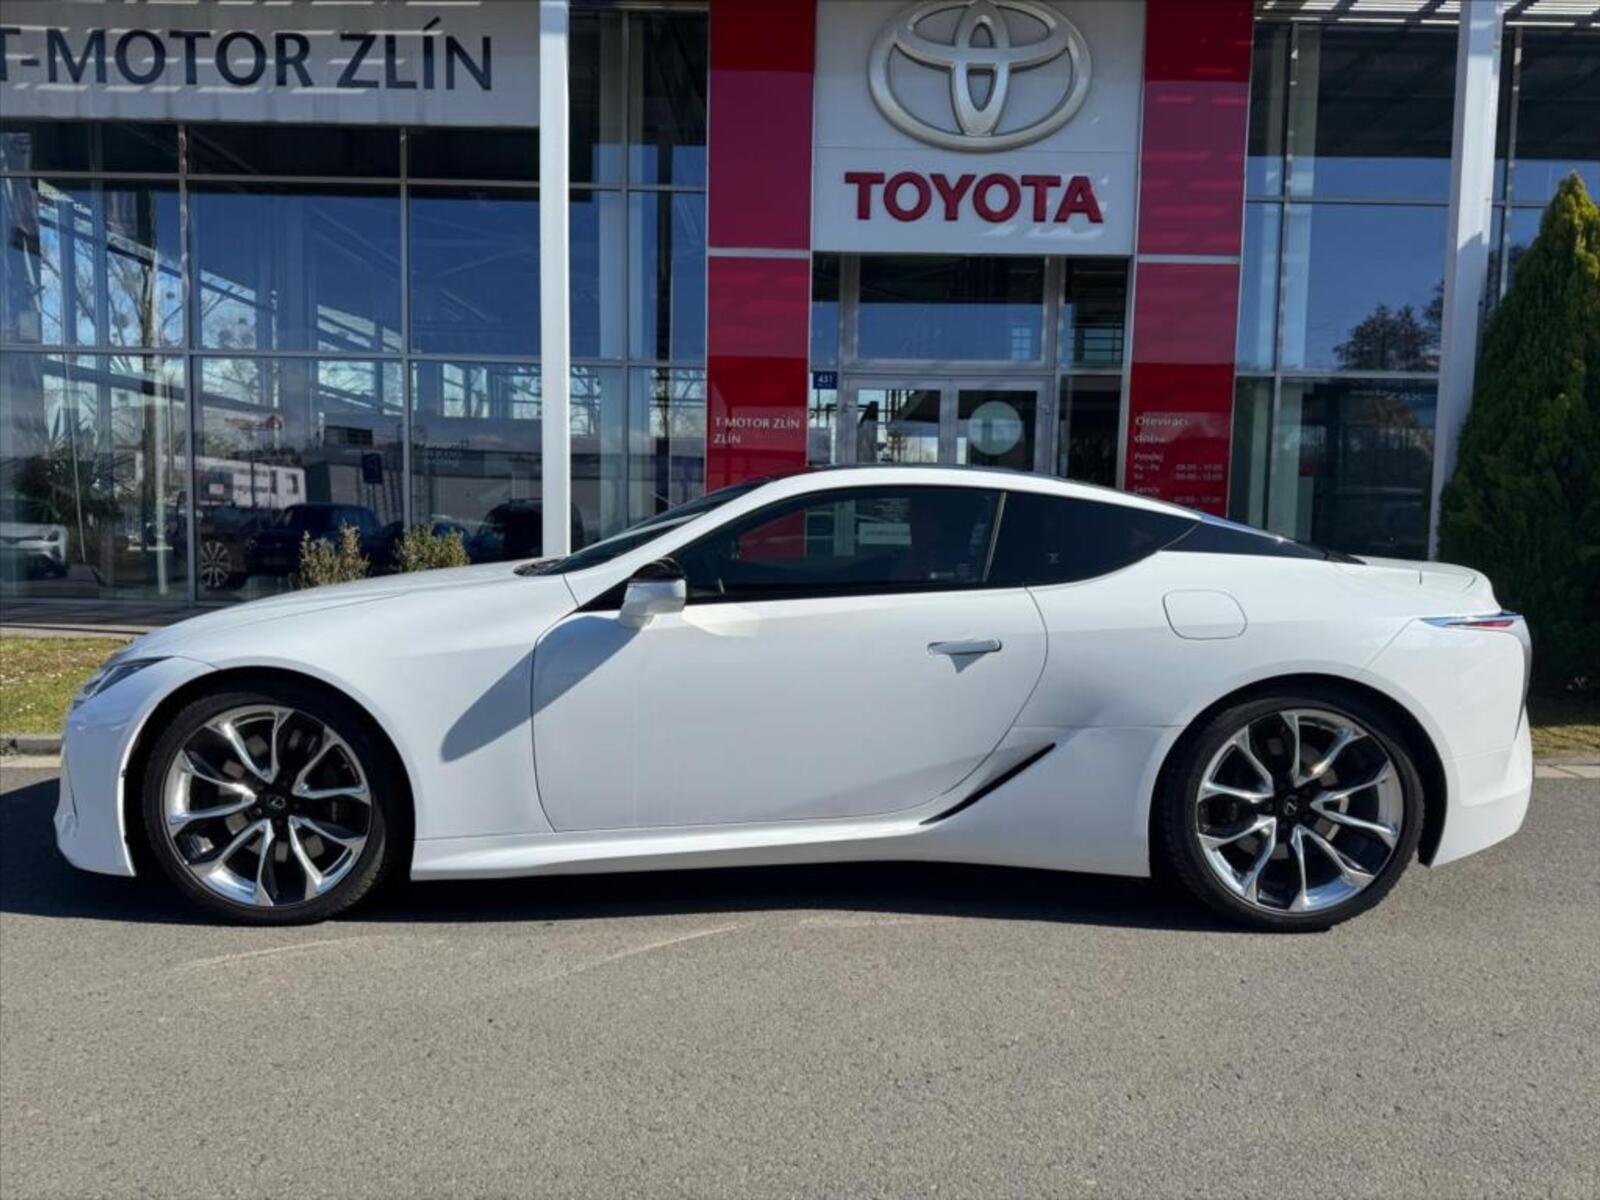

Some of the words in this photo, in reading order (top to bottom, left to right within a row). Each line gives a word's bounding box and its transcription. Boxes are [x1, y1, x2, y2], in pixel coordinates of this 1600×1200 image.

[0, 27, 313, 88] T-MOTOR
[337, 16, 493, 91] ZLÍN
[844, 171, 1104, 223] TOYOTA
[713, 431, 742, 445] ZLÍN
[715, 416, 770, 430] T-MOTOR
[774, 414, 801, 430] ZLÍN
